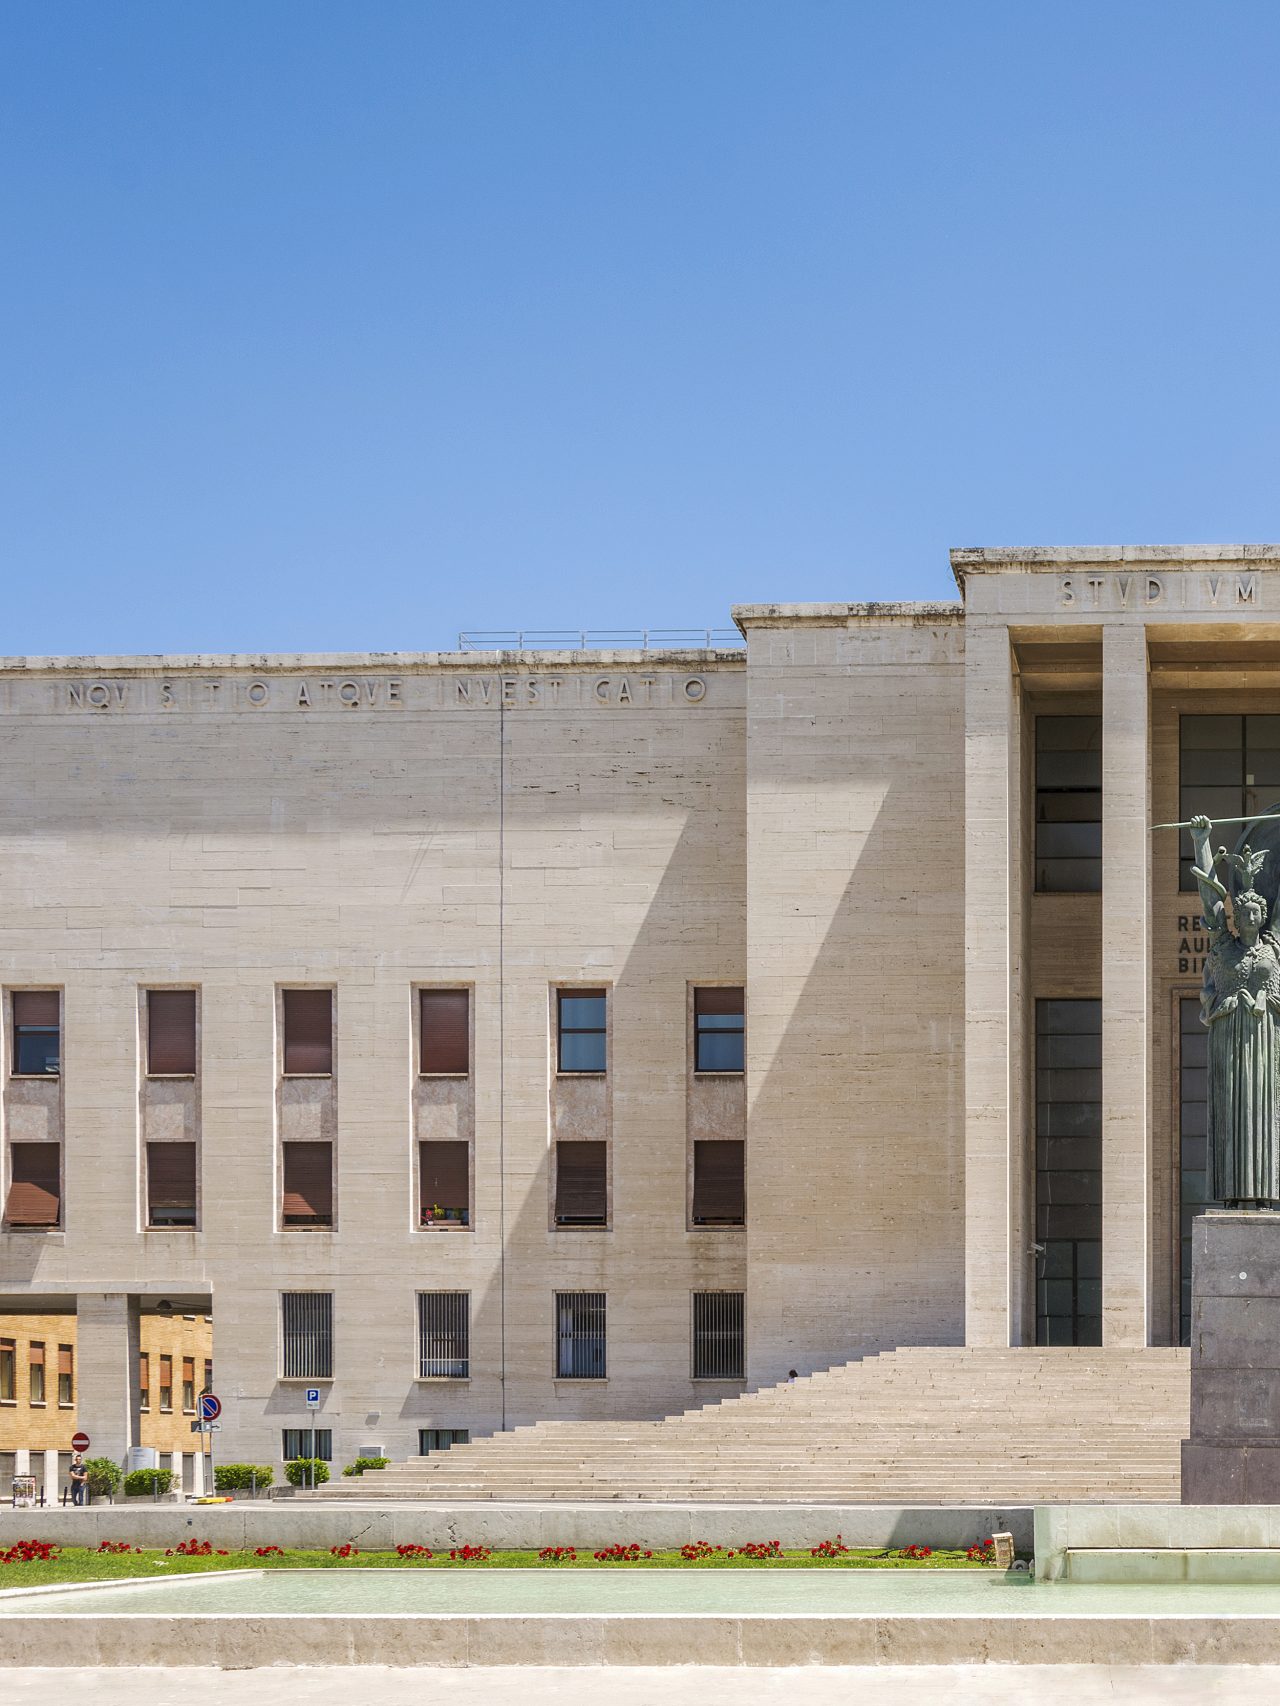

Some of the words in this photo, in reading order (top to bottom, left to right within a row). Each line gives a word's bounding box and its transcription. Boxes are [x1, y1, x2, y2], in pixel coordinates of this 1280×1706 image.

[1059, 576, 1255, 605] STVDIVM
[297, 680, 402, 706] ATQVE
[438, 677, 706, 704] INVESTIGATIO
